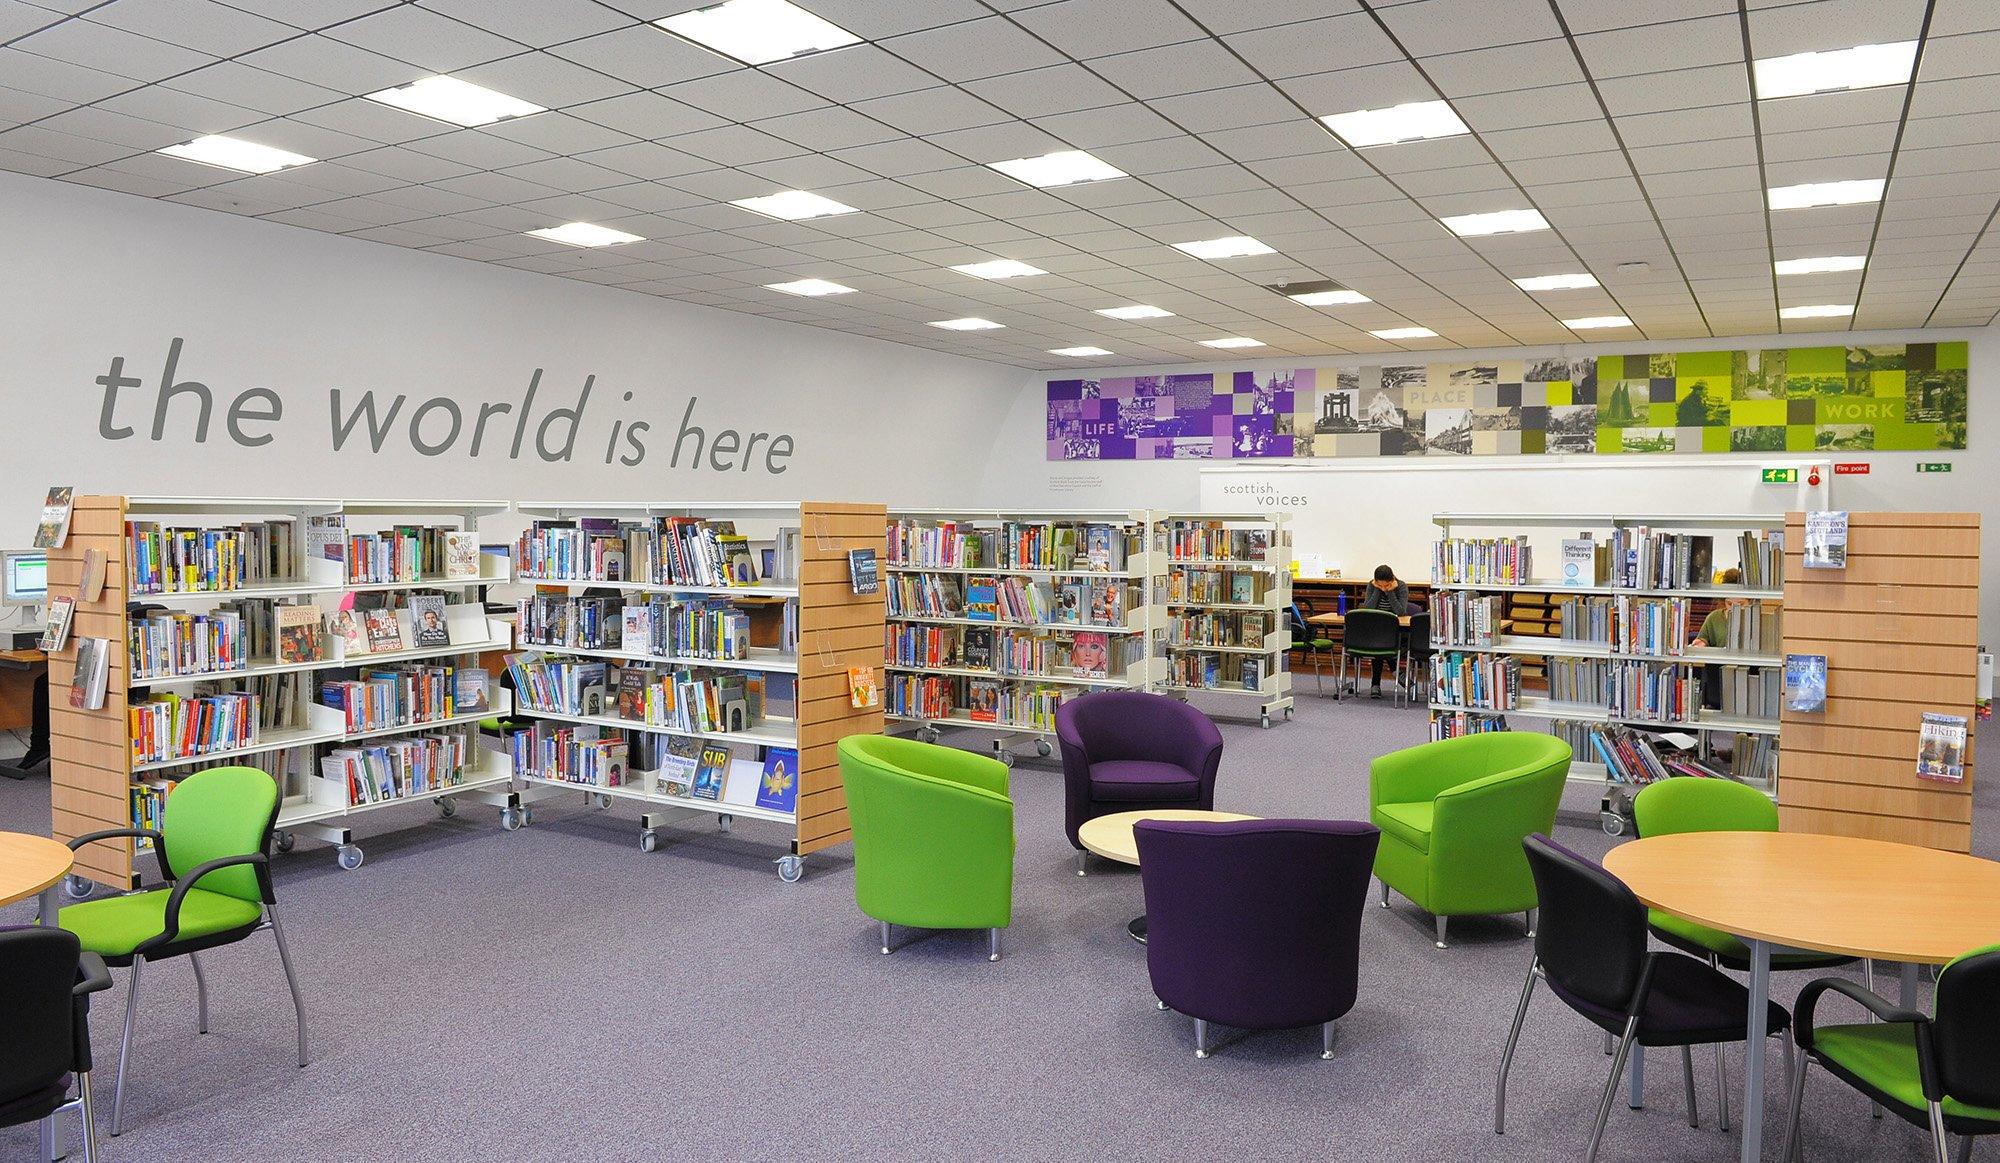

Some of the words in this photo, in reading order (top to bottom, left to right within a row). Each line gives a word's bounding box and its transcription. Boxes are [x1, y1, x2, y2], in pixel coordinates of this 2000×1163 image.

[1410, 390, 1467, 404] PLACE
[95, 336, 283, 447] the
[329, 367, 596, 463] world
[605, 390, 651, 467] is
[670, 396, 795, 475] here
[1824, 403, 1896, 419] WORK
[1085, 423, 1115, 436] LIFE
[1257, 491, 1308, 506] voices
[1565, 551, 1592, 560] Thinking
[859, 582, 878, 591] ARGO
[702, 750, 726, 769] SUB
